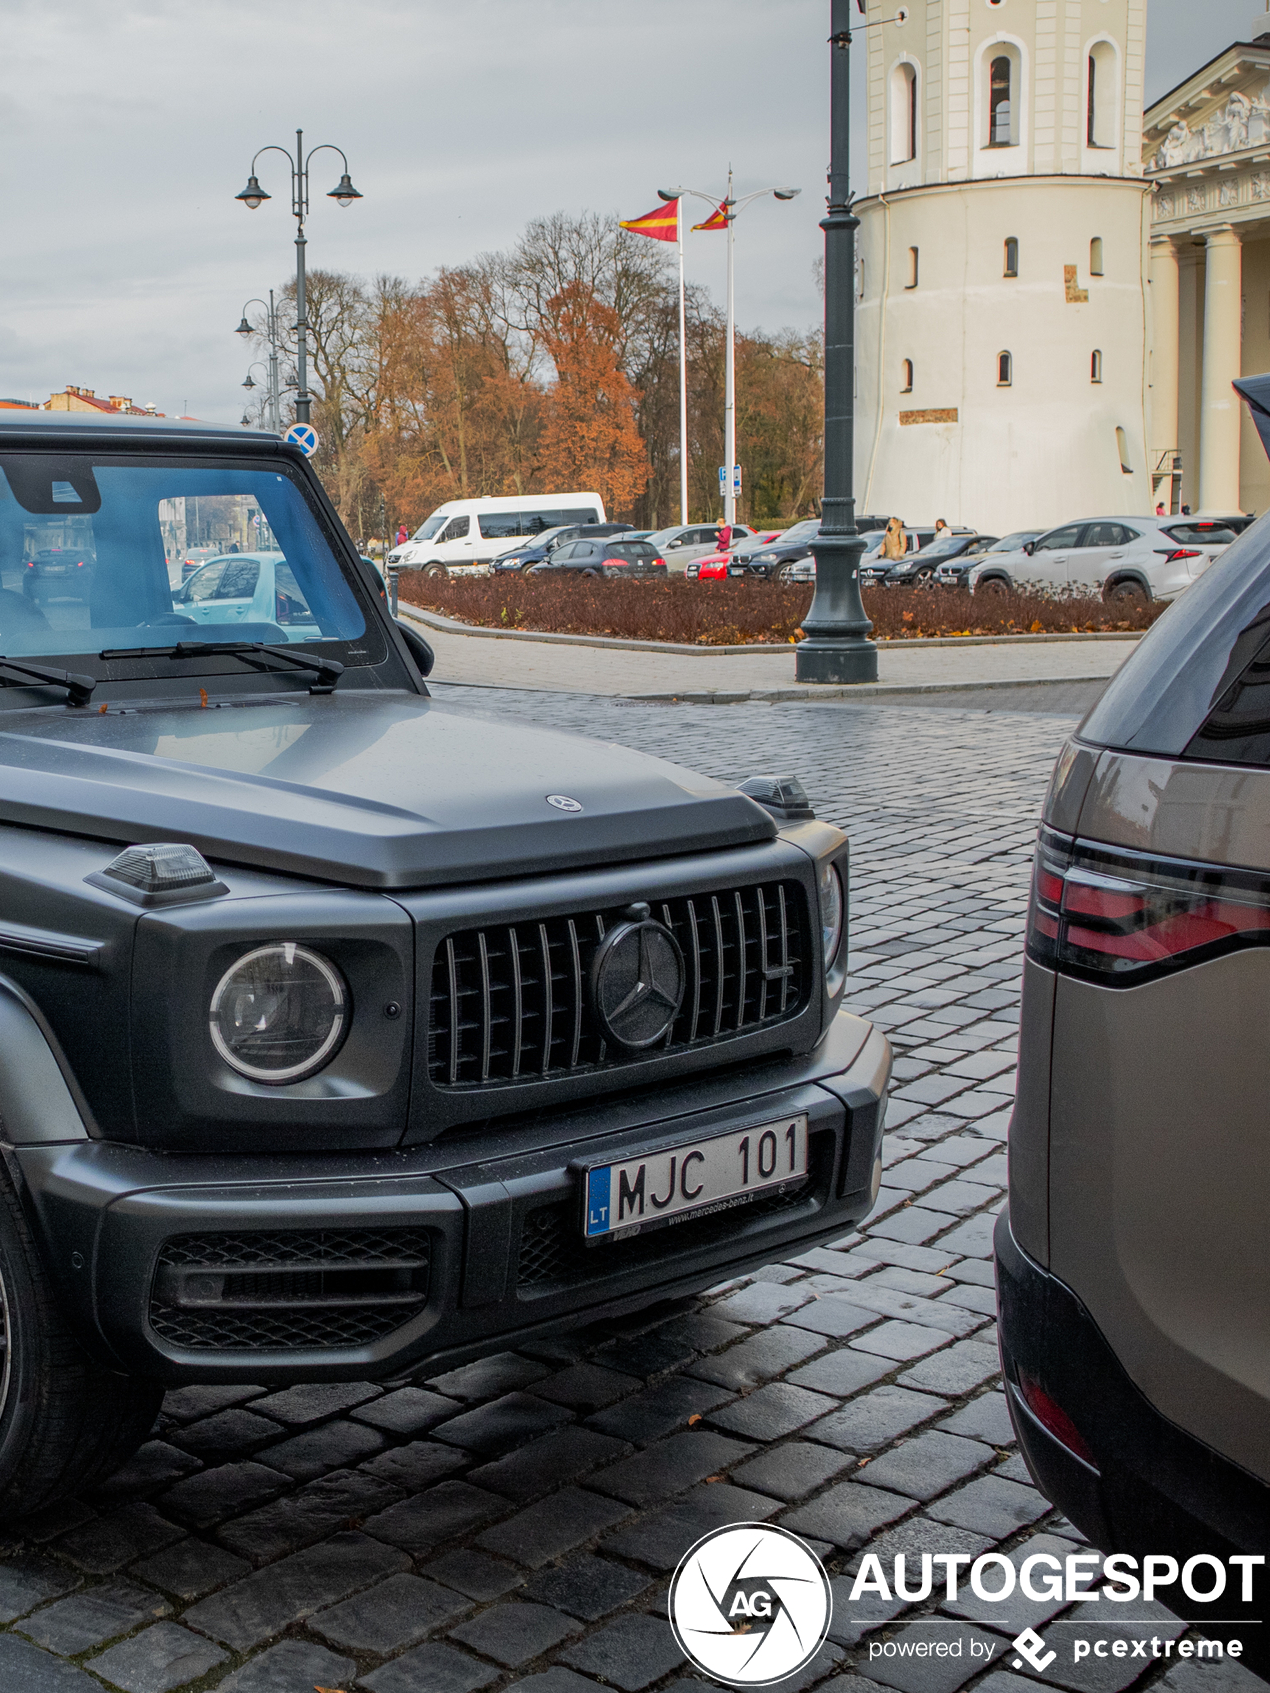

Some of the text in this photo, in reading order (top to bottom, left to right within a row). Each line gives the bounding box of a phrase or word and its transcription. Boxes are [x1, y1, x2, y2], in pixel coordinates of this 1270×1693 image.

[618, 1123, 796, 1221] MJC 101
[590, 1206, 608, 1225] LT
[668, 1193, 754, 1226] www.mercedes-benz.lt
